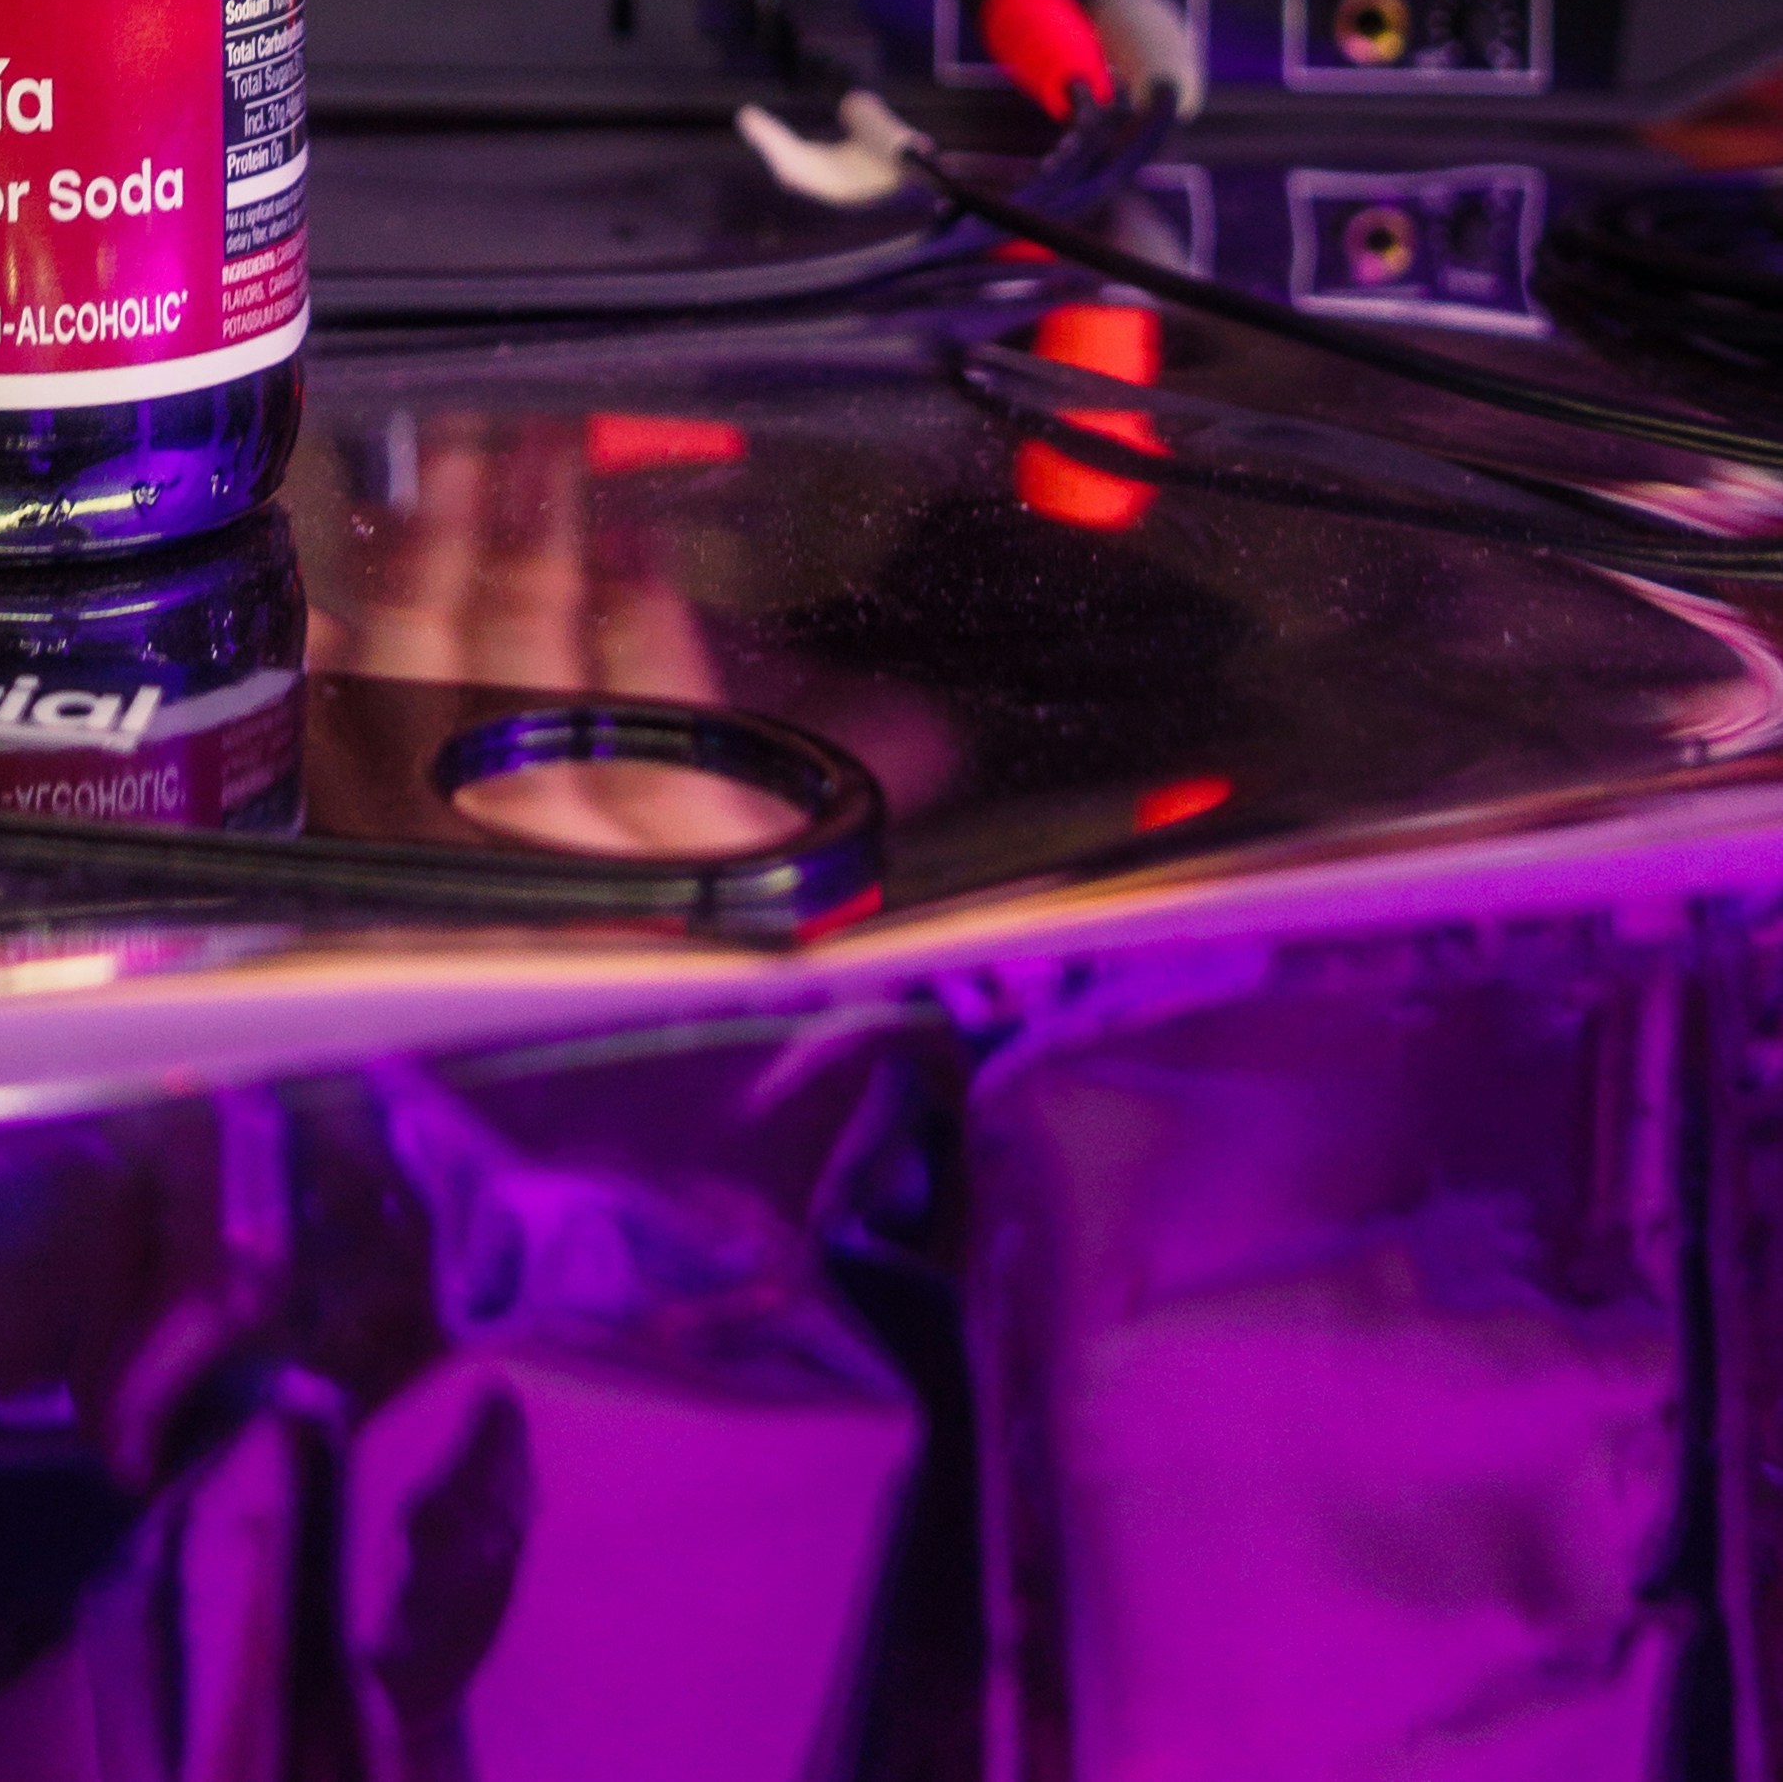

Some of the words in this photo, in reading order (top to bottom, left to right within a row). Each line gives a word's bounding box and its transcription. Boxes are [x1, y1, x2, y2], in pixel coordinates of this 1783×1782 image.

[225, 35, 256, 67] Total
[231, 70, 263, 101] Total
[226, 143, 269, 179] Protein
[48, 158, 185, 223] Soda
